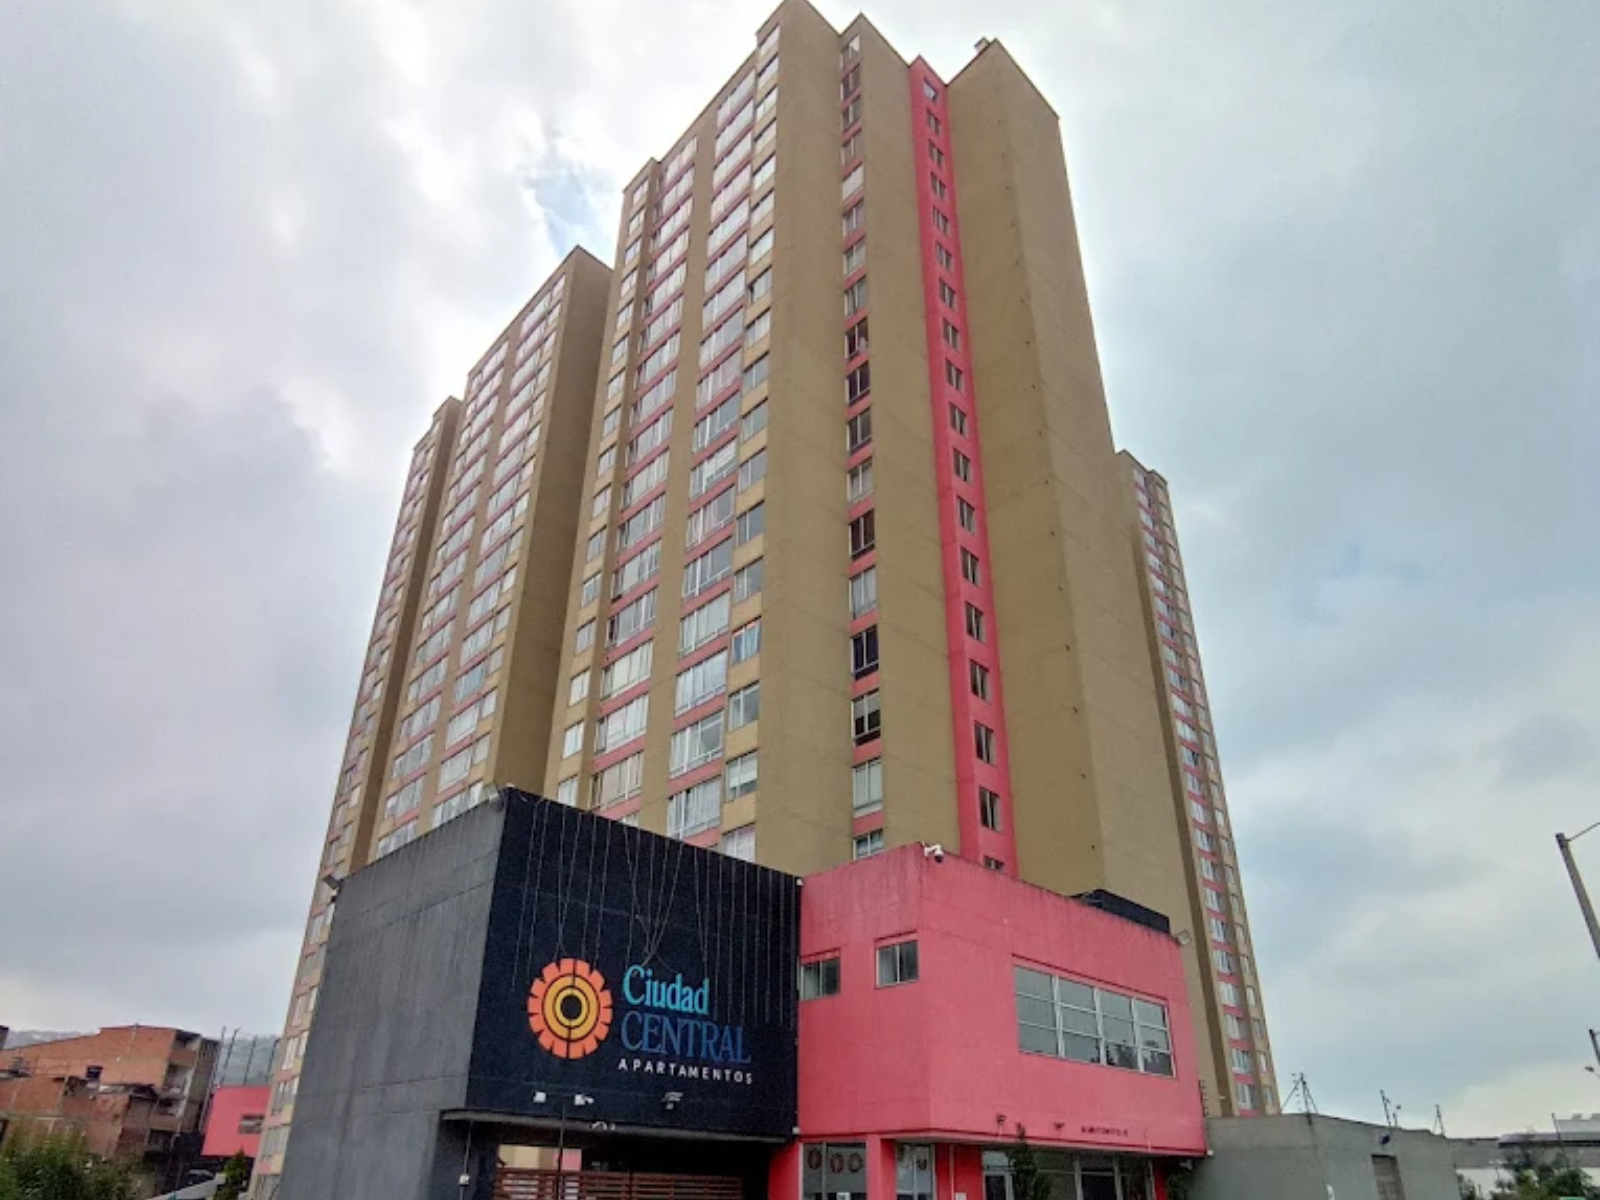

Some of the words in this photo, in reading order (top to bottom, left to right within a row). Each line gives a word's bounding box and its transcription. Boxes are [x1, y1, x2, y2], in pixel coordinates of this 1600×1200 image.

[622, 964, 710, 1014] Ciudad
[620, 1009, 751, 1064] CENTRAL
[618, 1058, 754, 1085] APARTAMENTOS
